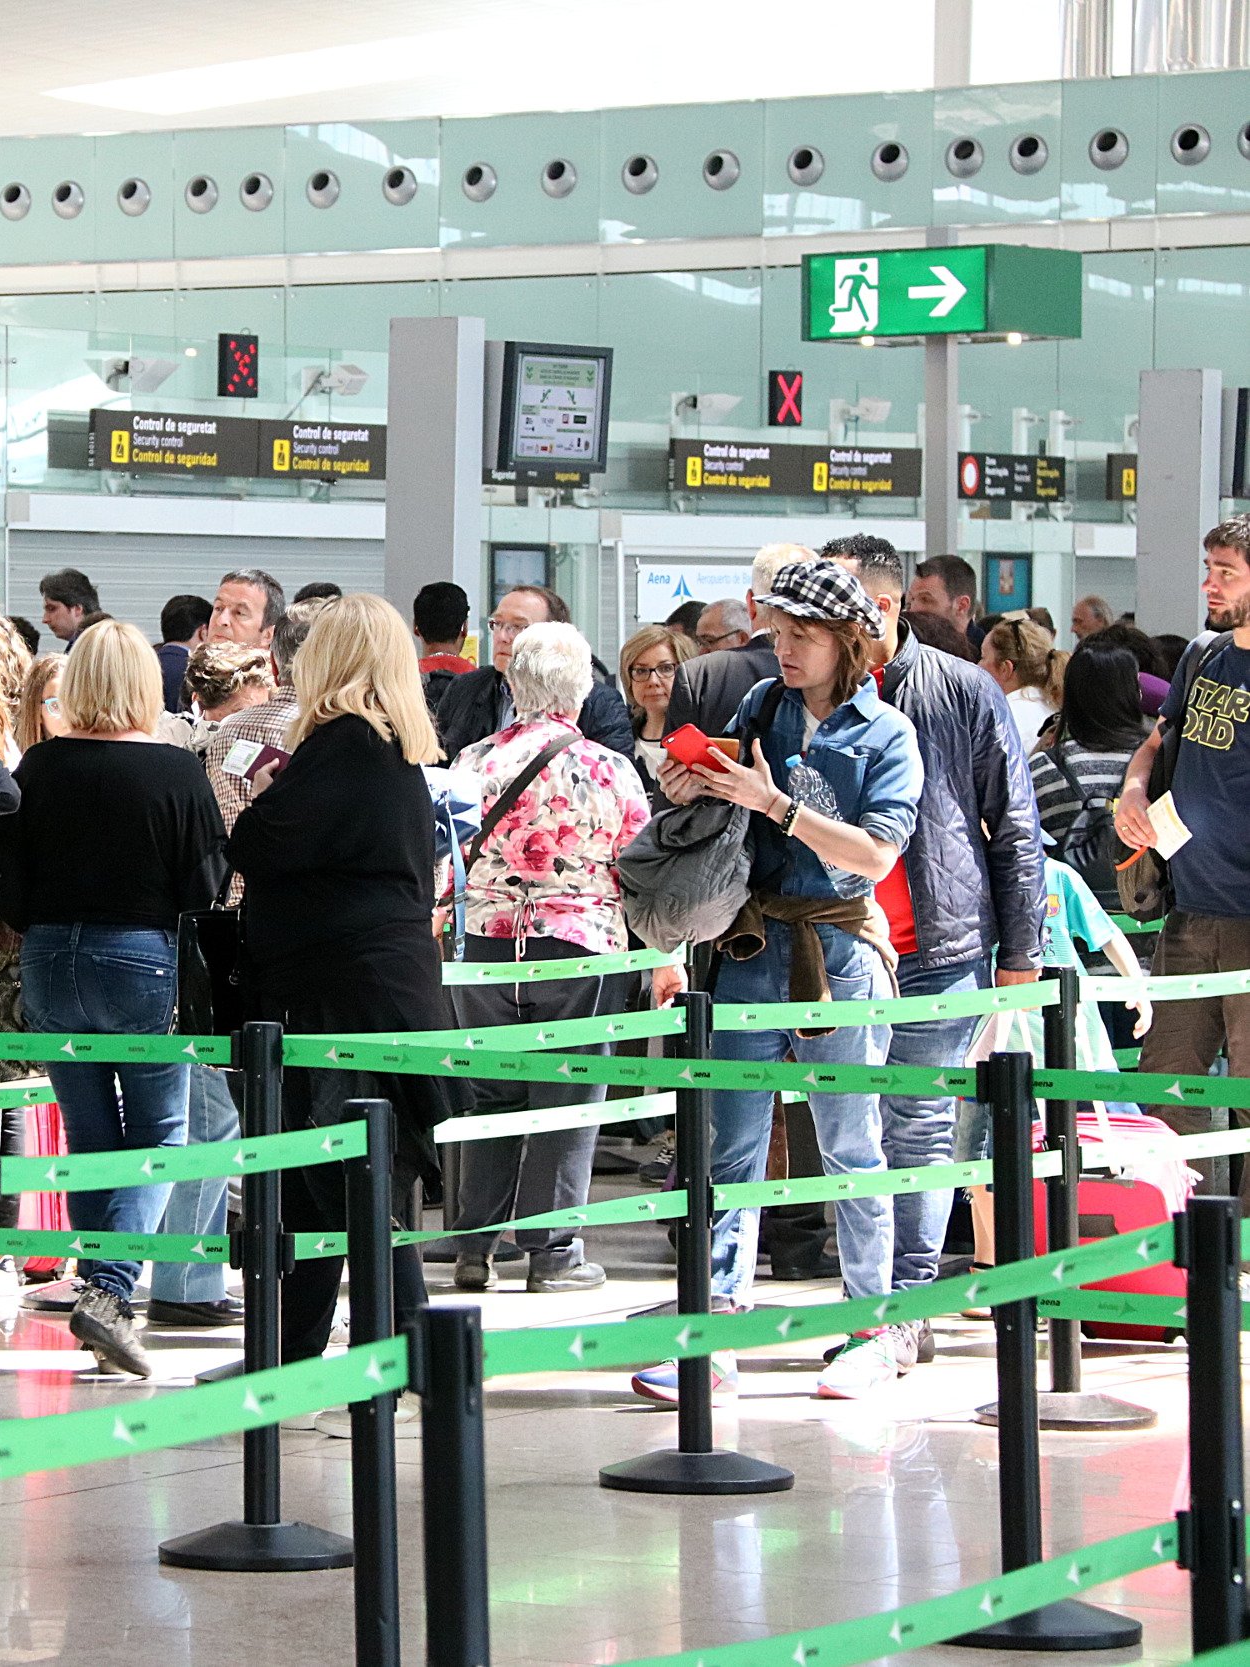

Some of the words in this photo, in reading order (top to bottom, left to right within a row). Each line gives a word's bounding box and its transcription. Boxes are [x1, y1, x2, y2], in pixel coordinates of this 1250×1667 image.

[133, 416, 163, 430] Control
[165, 418, 175, 431] de
[178, 421, 216, 435] seguretat
[133, 433, 159, 448] Security
[161, 436, 183, 447] control
[293, 425, 321, 439] Control
[322, 427, 332, 440] de
[334, 429, 369, 443] seguretat
[293, 442, 317, 455] Security
[318, 444, 339, 454] control
[132, 449, 162, 462] Control
[165, 451, 174, 463] de
[177, 452, 218, 467] seguridad
[292, 456, 320, 469] Control
[322, 458, 330, 470] de
[333, 459, 370, 474] seguridad
[648, 572, 670, 584] Aena
[696, 572, 730, 584] Aeropuerto
